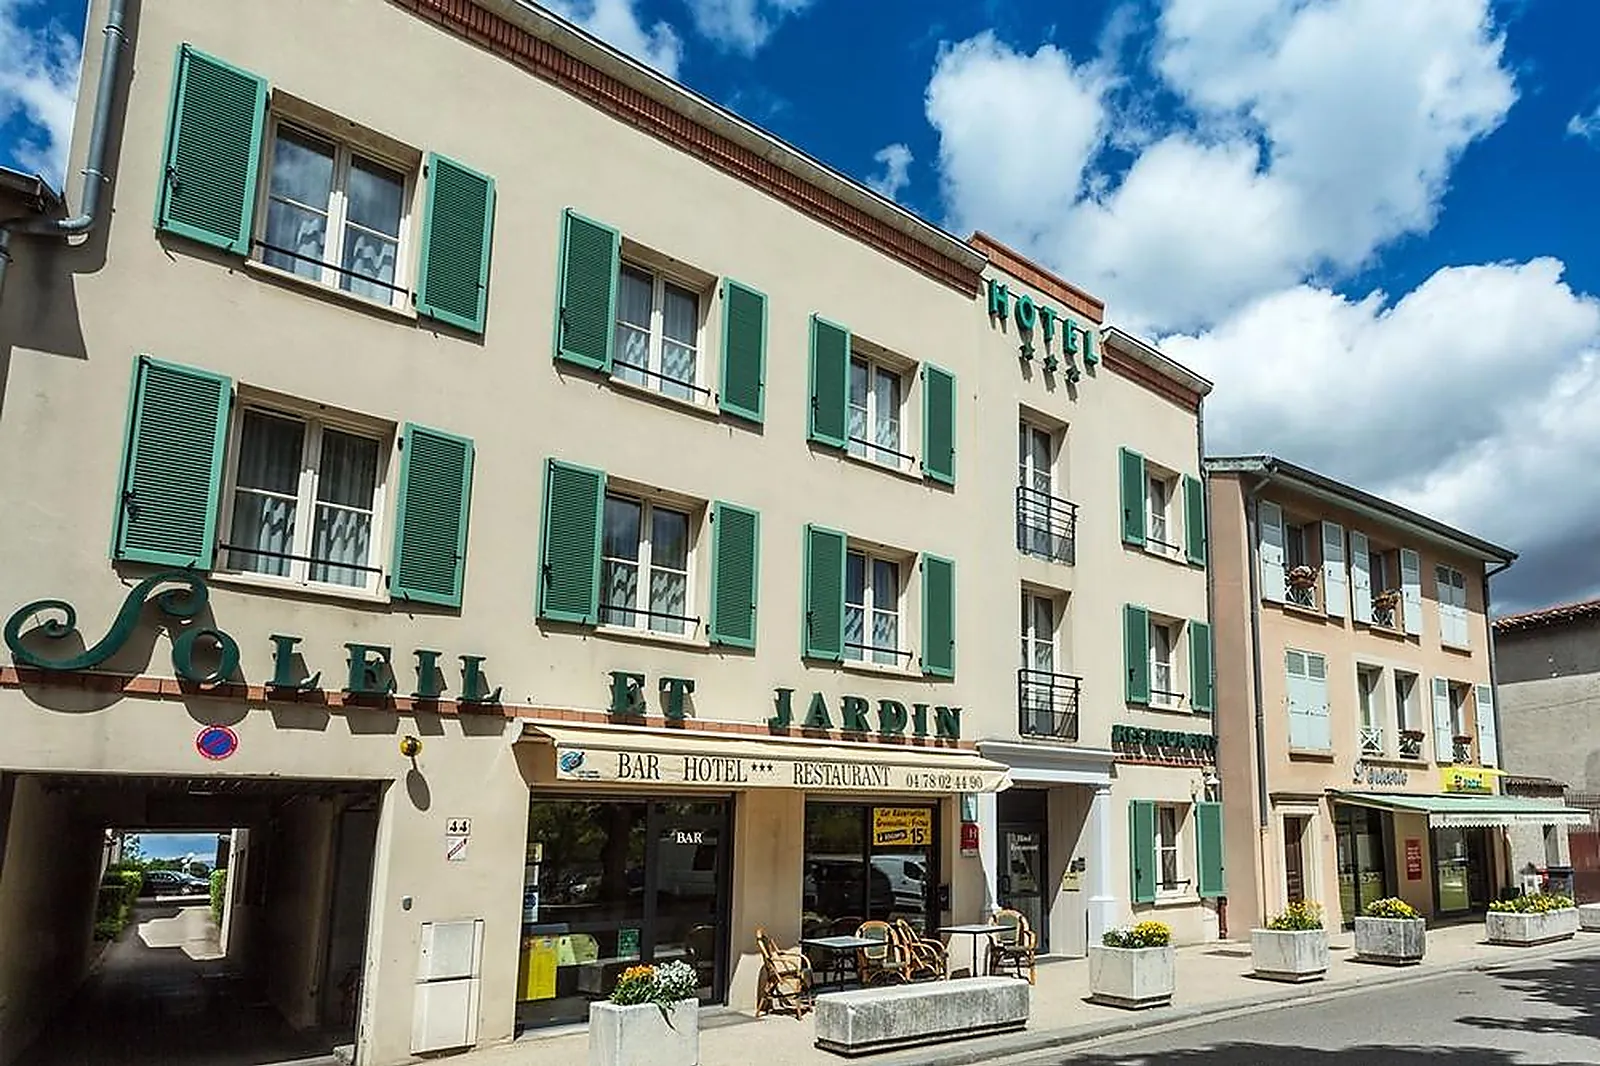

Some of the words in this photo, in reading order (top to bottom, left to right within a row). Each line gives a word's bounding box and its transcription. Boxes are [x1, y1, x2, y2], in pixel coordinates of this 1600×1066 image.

[988, 279, 1099, 365] HOTEL
[4, 571, 502, 704] SOLEIL
[608, 671, 695, 720] ET
[768, 687, 963, 740] JARDIN
[617, 753, 660, 780] BAR
[683, 756, 748, 783] HOTEL
[793, 762, 891, 787] RESTAURANT
[922, 773, 936, 789] 78
[939, 774, 951, 789] 02
[449, 820, 468, 832] 44
[676, 831, 704, 844] BAR
